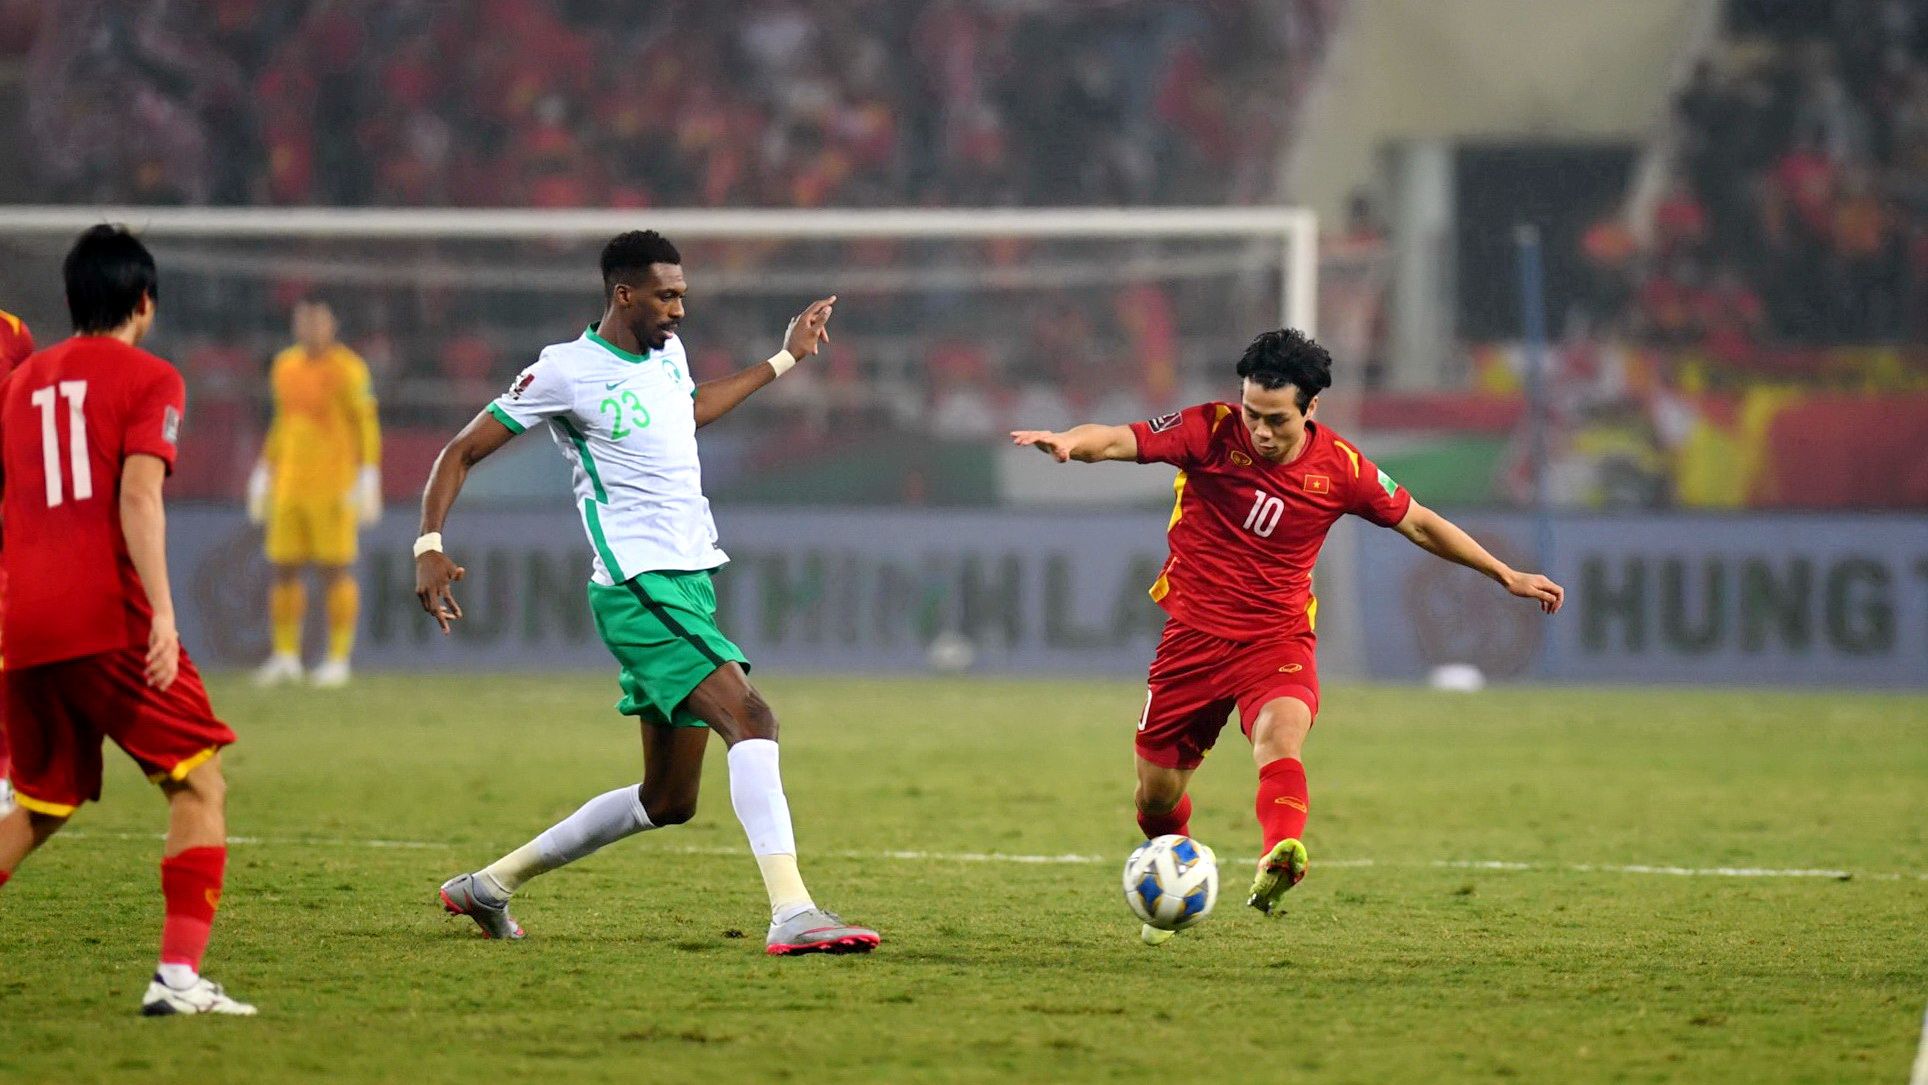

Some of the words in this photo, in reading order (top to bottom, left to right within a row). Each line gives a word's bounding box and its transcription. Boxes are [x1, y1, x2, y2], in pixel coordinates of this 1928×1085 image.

[31, 380, 93, 508] 11
[600, 390, 651, 441] 23
[1242, 489, 1285, 538] 10
[368, 549, 592, 643] HUN
[1580, 552, 1896, 654] HUNG
